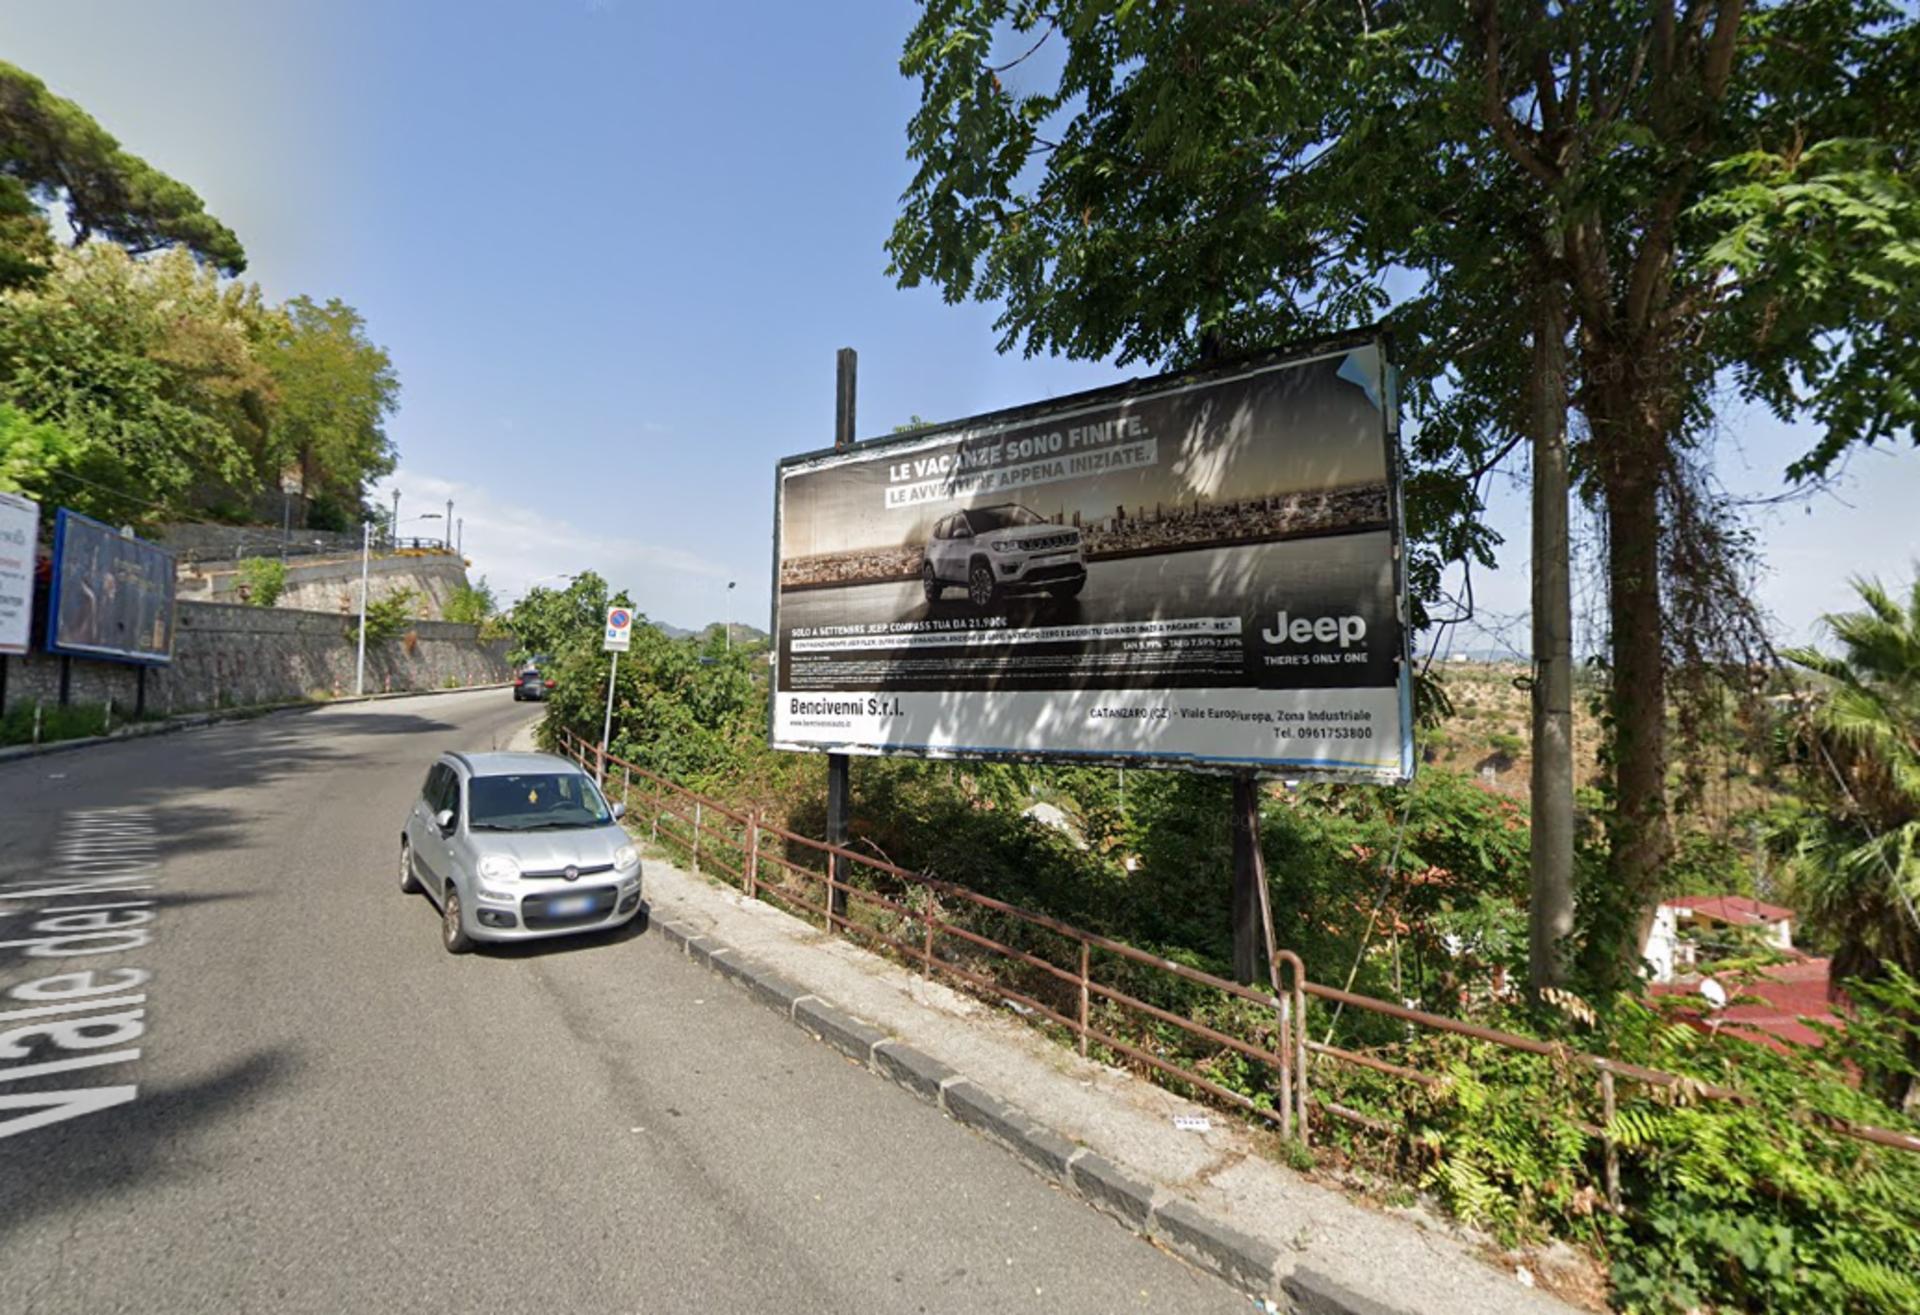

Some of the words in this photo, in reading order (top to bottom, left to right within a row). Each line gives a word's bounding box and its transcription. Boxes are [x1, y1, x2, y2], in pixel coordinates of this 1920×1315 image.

[889, 462, 911, 482] LE
[1006, 432, 1062, 461] SONO
[1069, 416, 1149, 448] FINITE.
[889, 490, 906, 504] LE
[1000, 464, 1065, 486] APPENA
[1070, 446, 1151, 473] INIZIATE.
[791, 628, 811, 638] SOLO
[812, 628, 819, 636] A
[890, 621, 931, 633] COMPASS
[933, 620, 952, 630] TUA
[953, 619, 967, 629] DA
[1262, 611, 1367, 648] Jeep
[1264, 655, 1310, 666] THERE'S
[1312, 653, 1341, 664] ONLY
[1344, 652, 1368, 663] ONE
[790, 697, 864, 715] Bencivenni
[868, 697, 904, 716] S.r.l.
[1090, 706, 1147, 719] CATANZARO
[1150, 707, 1172, 720] (CZ)
[1180, 708, 1206, 719] Viale
[1277, 710, 1305, 721] Zona
[1307, 709, 1372, 721] Industriale
[1273, 727, 1295, 739] Tel.
[1297, 727, 1372, 739] 0961753800
